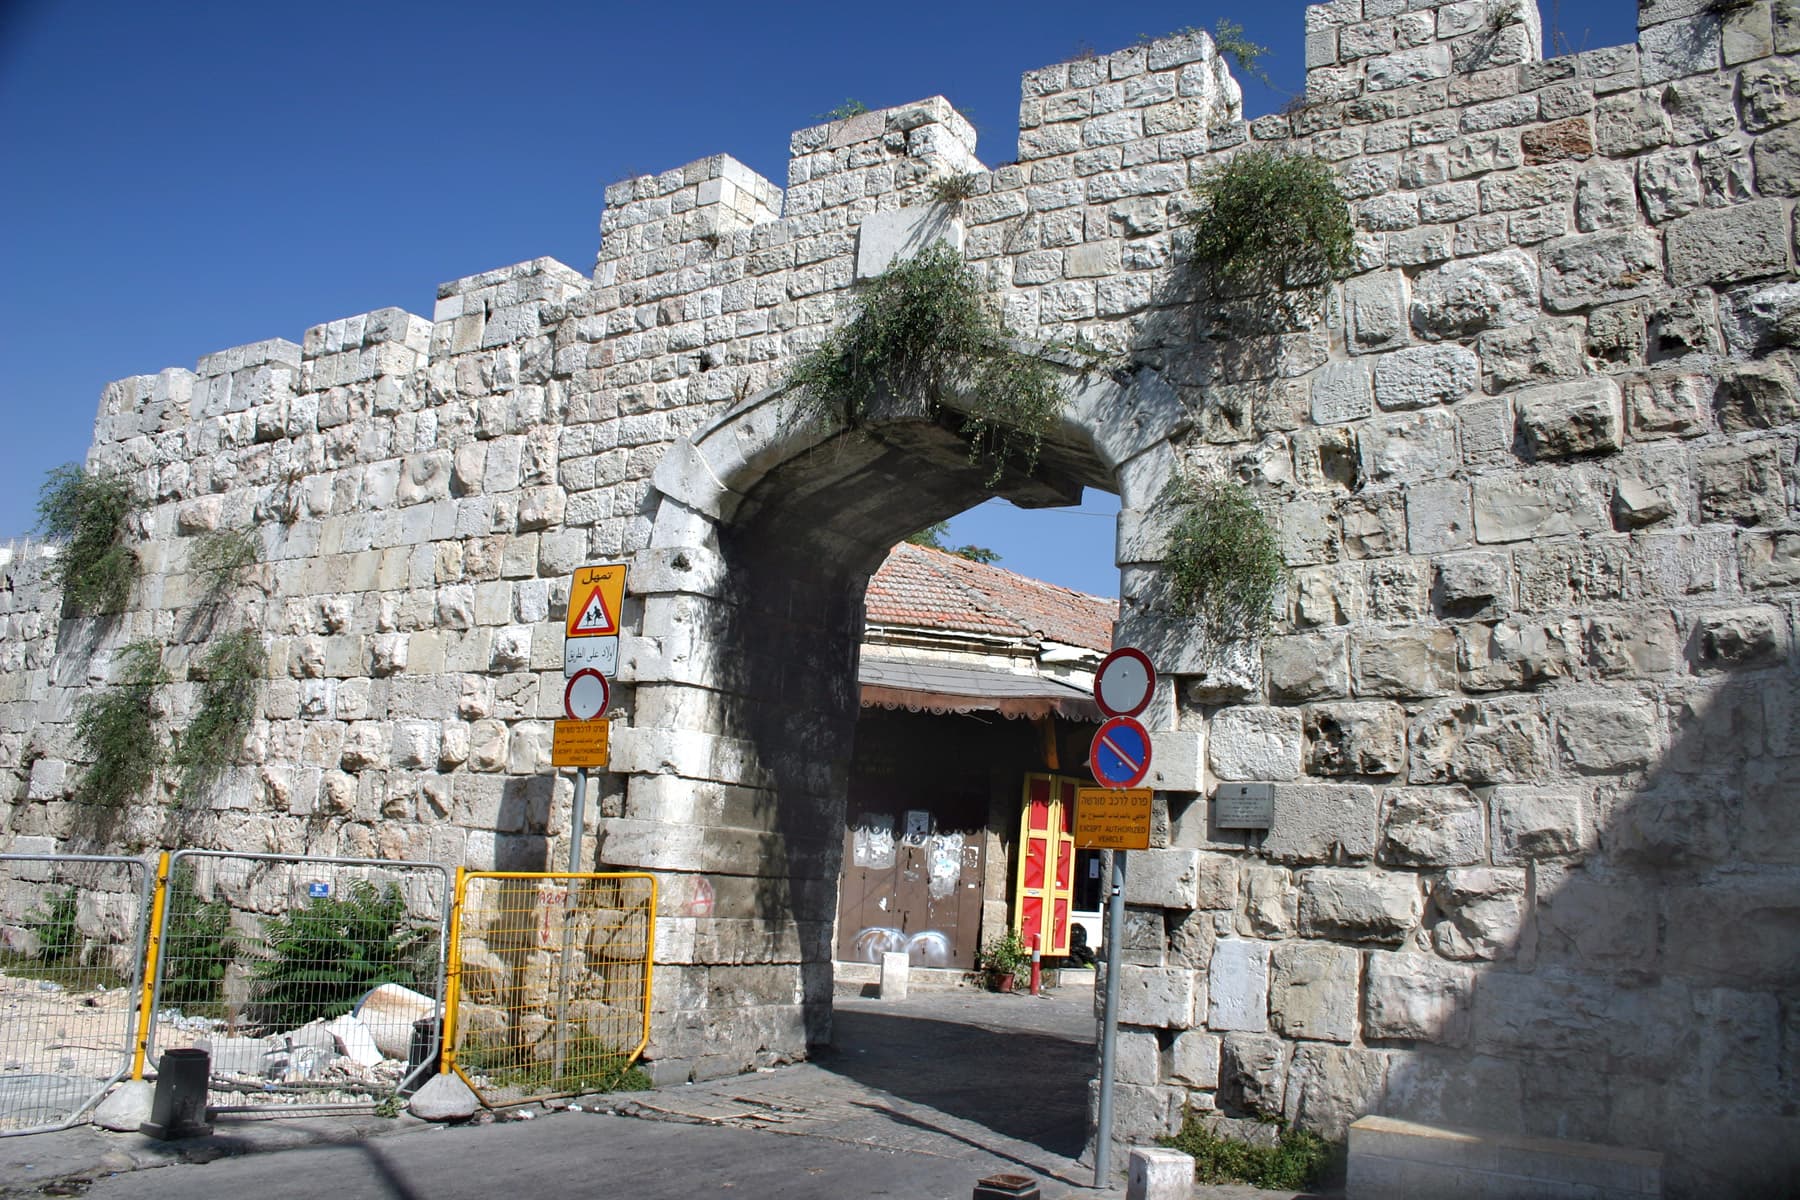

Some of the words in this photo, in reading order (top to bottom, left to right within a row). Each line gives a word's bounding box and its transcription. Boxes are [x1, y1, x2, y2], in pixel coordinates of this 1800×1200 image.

[582, 569, 613, 584] تمهل
[567, 647, 586, 663] الطريق
[587, 648, 599, 662] على
[1081, 797, 1105, 806] מורשה
[1108, 795, 1128, 806] לרכב
[1131, 797, 1148, 806] פרט
[1105, 825, 1146, 834] AUTHORIZED
